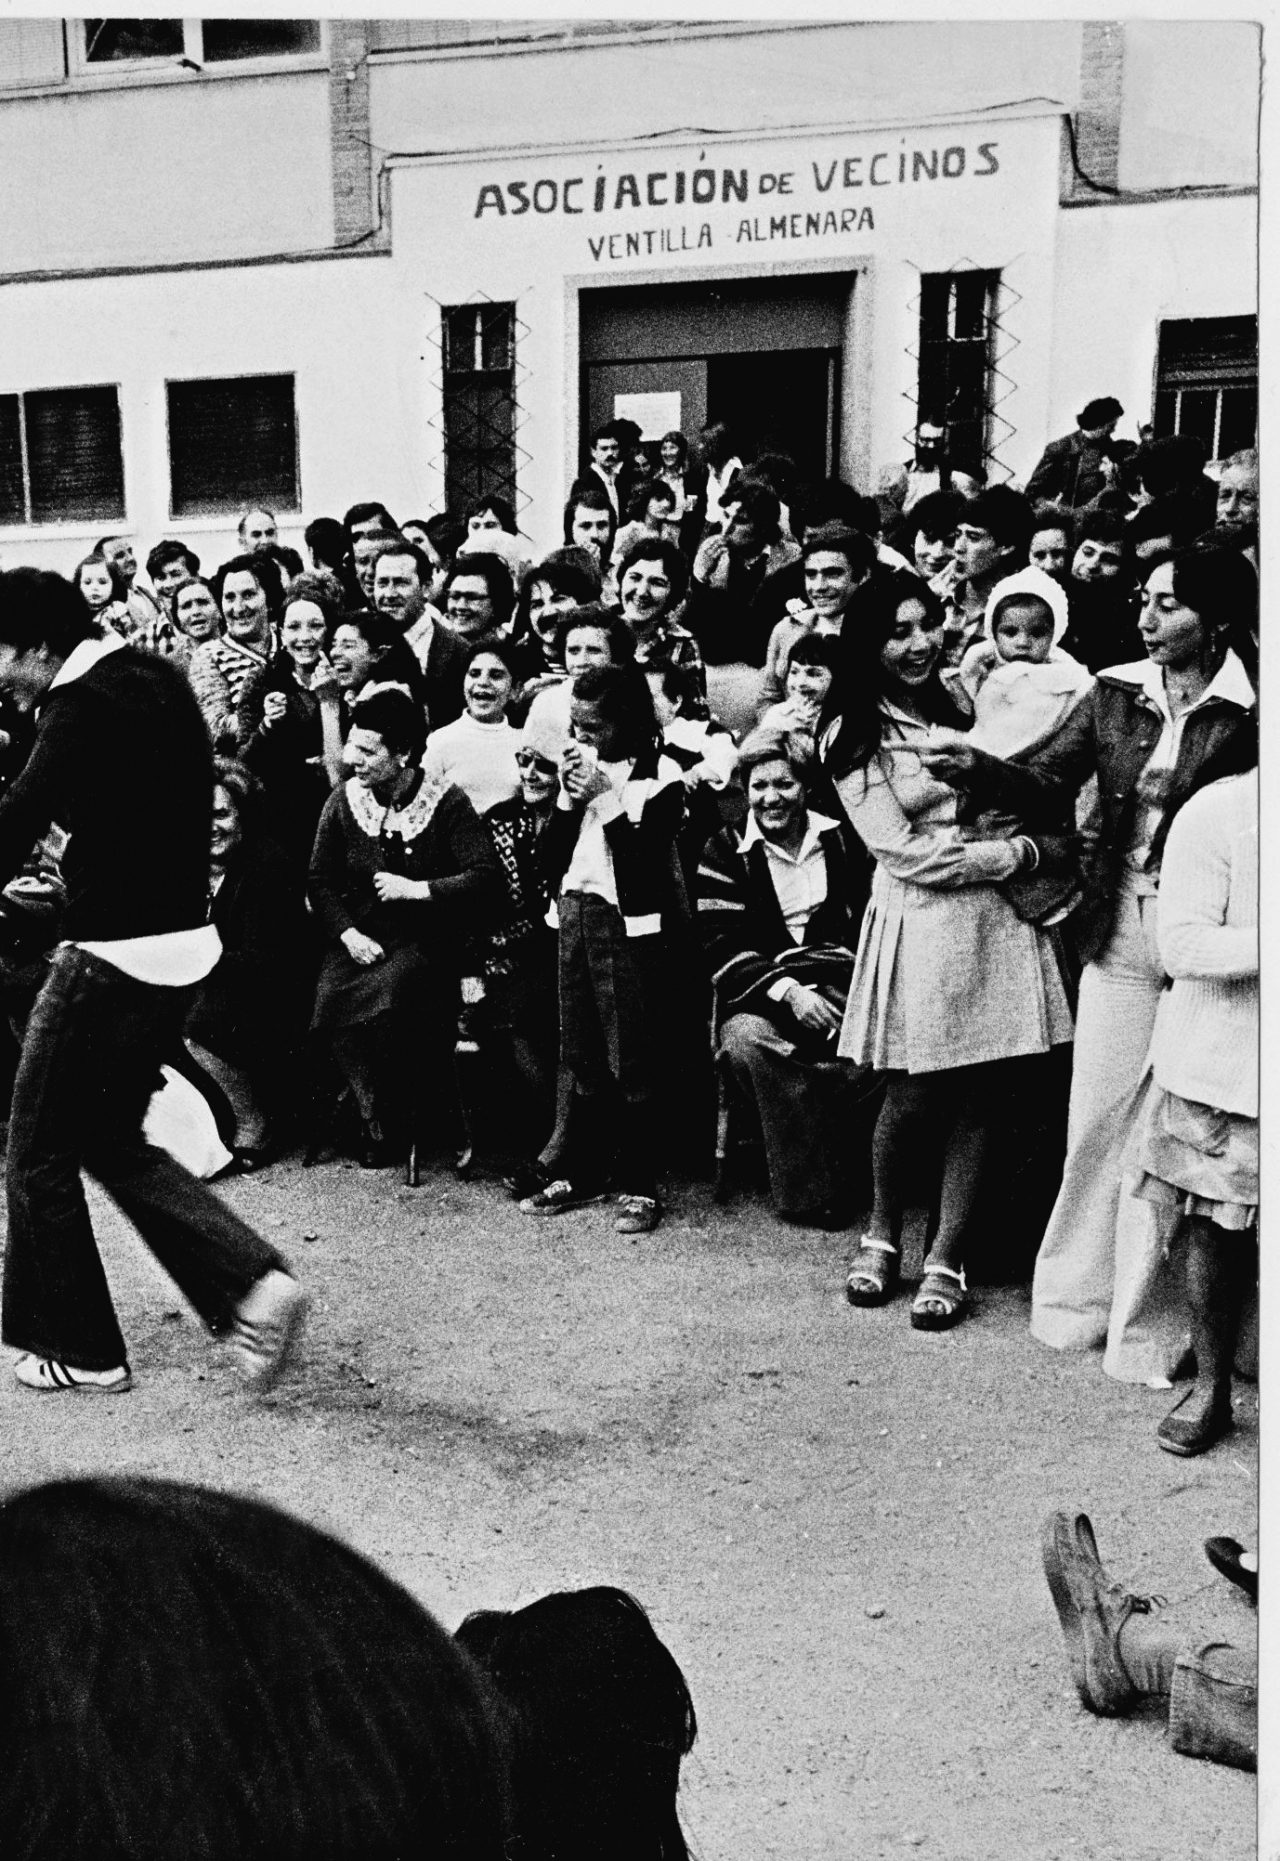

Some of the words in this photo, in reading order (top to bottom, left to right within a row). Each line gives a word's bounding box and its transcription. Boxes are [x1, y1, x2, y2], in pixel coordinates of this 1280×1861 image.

[757, 172, 795, 195] DE
[587, 222, 713, 262] VENTILLA
[735, 206, 876, 244] ALMENARA
